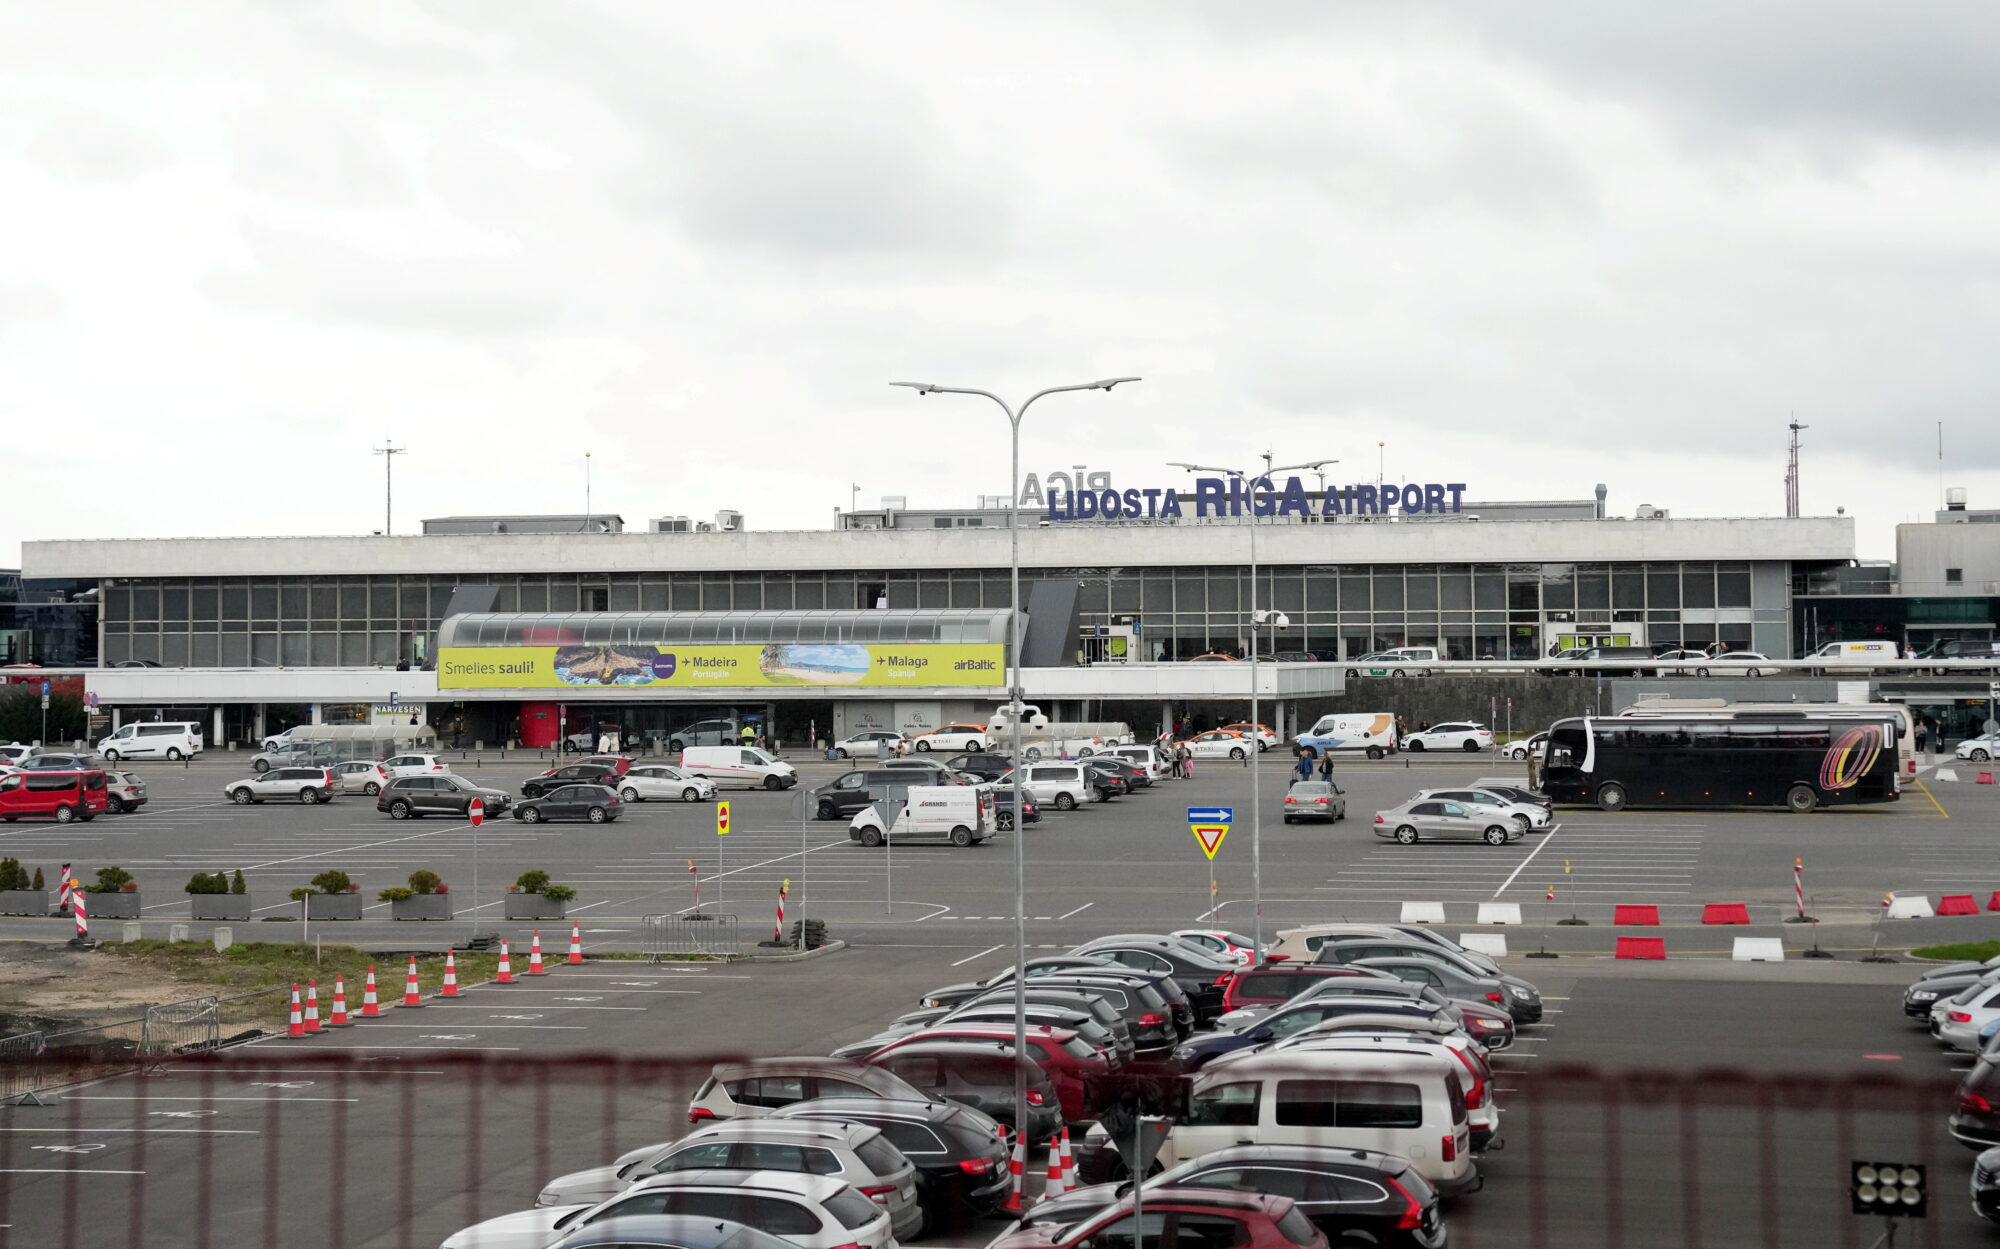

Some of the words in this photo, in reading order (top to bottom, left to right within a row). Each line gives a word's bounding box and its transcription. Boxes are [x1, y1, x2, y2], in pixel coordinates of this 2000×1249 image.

[1049, 488, 1182, 520] LIDOSTA
[1196, 470, 1311, 517] RĪGA
[1322, 483, 1466, 515] AIRPORT
[445, 661, 496, 675] Smelies
[498, 661, 534, 674] sauli!
[693, 657, 737, 667] Madeira
[888, 656, 928, 668] Malaga
[954, 659, 996, 670] airBaltic
[43, 682, 49, 694] P
[375, 705, 421, 713] NARVESEN
